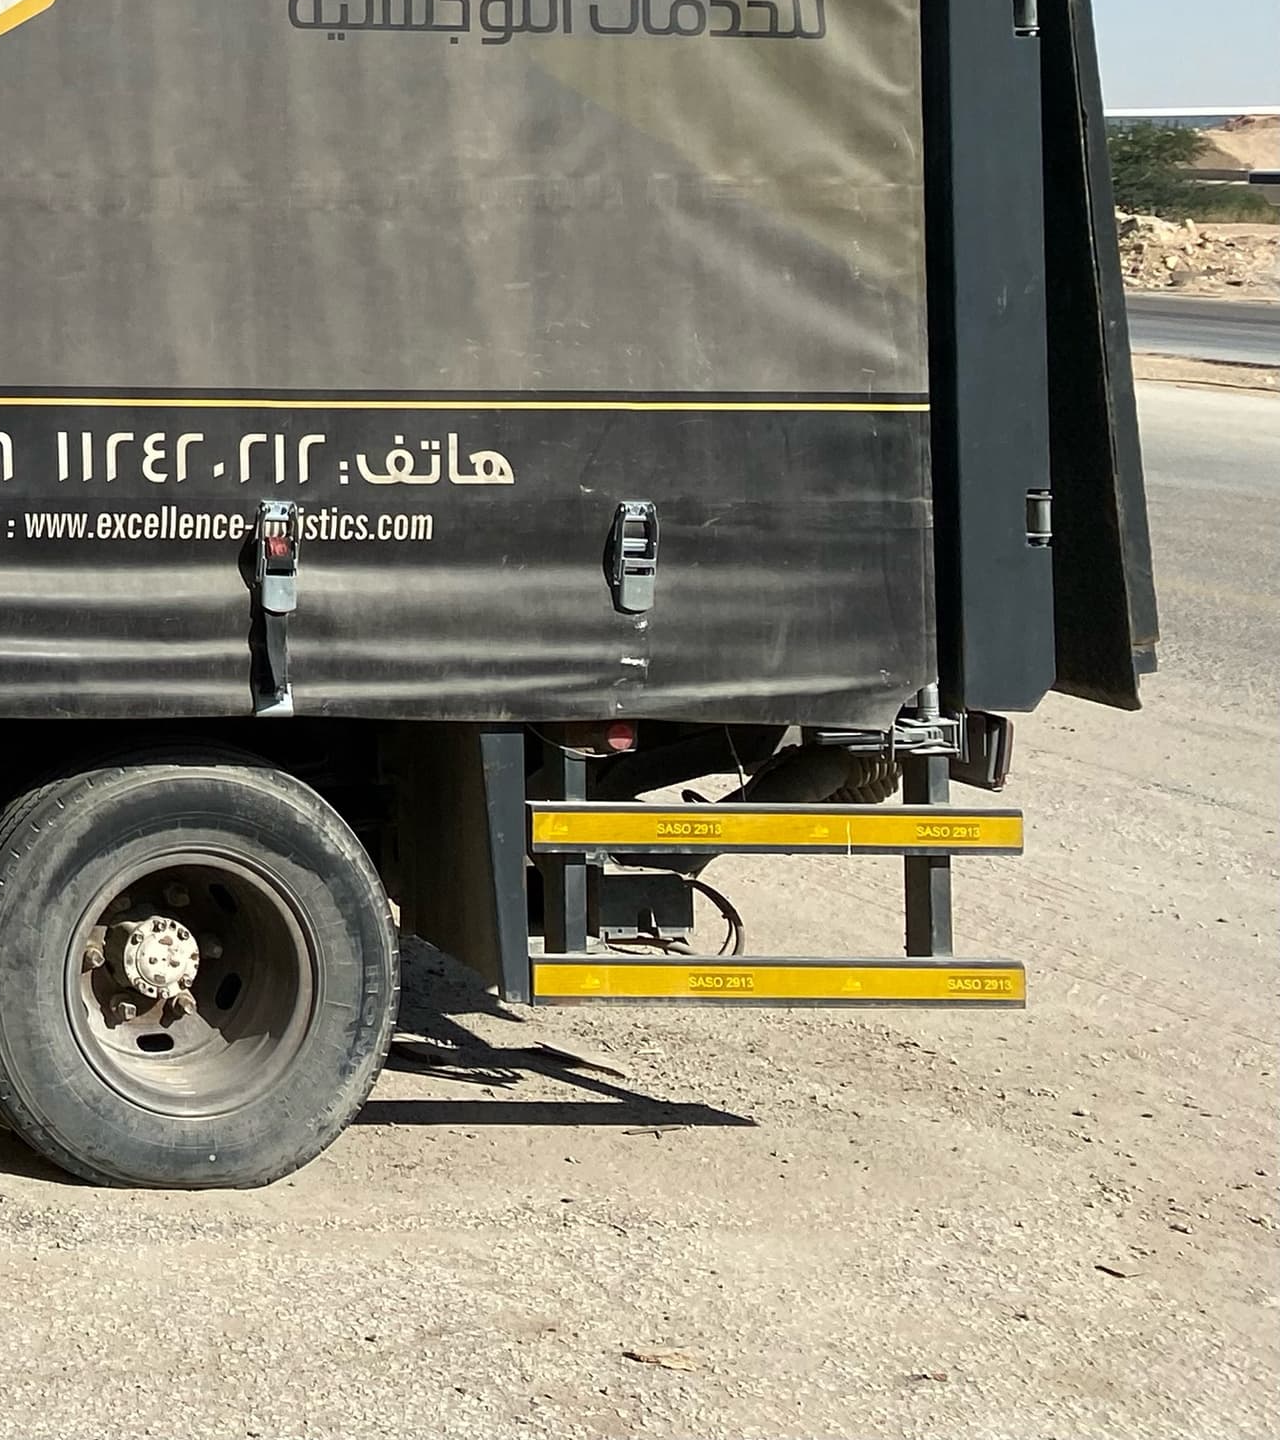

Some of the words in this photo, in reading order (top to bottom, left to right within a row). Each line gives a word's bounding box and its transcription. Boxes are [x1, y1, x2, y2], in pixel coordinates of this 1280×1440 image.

[656, 823, 691, 835] SASO
[694, 823, 721, 835] 2913
[916, 826, 950, 838] SASO
[952, 826, 980, 838] 2913
[688, 976, 723, 988] SASO
[726, 976, 754, 988] 2913
[947, 979, 981, 991] SASO
[984, 979, 1012, 991] 2913
